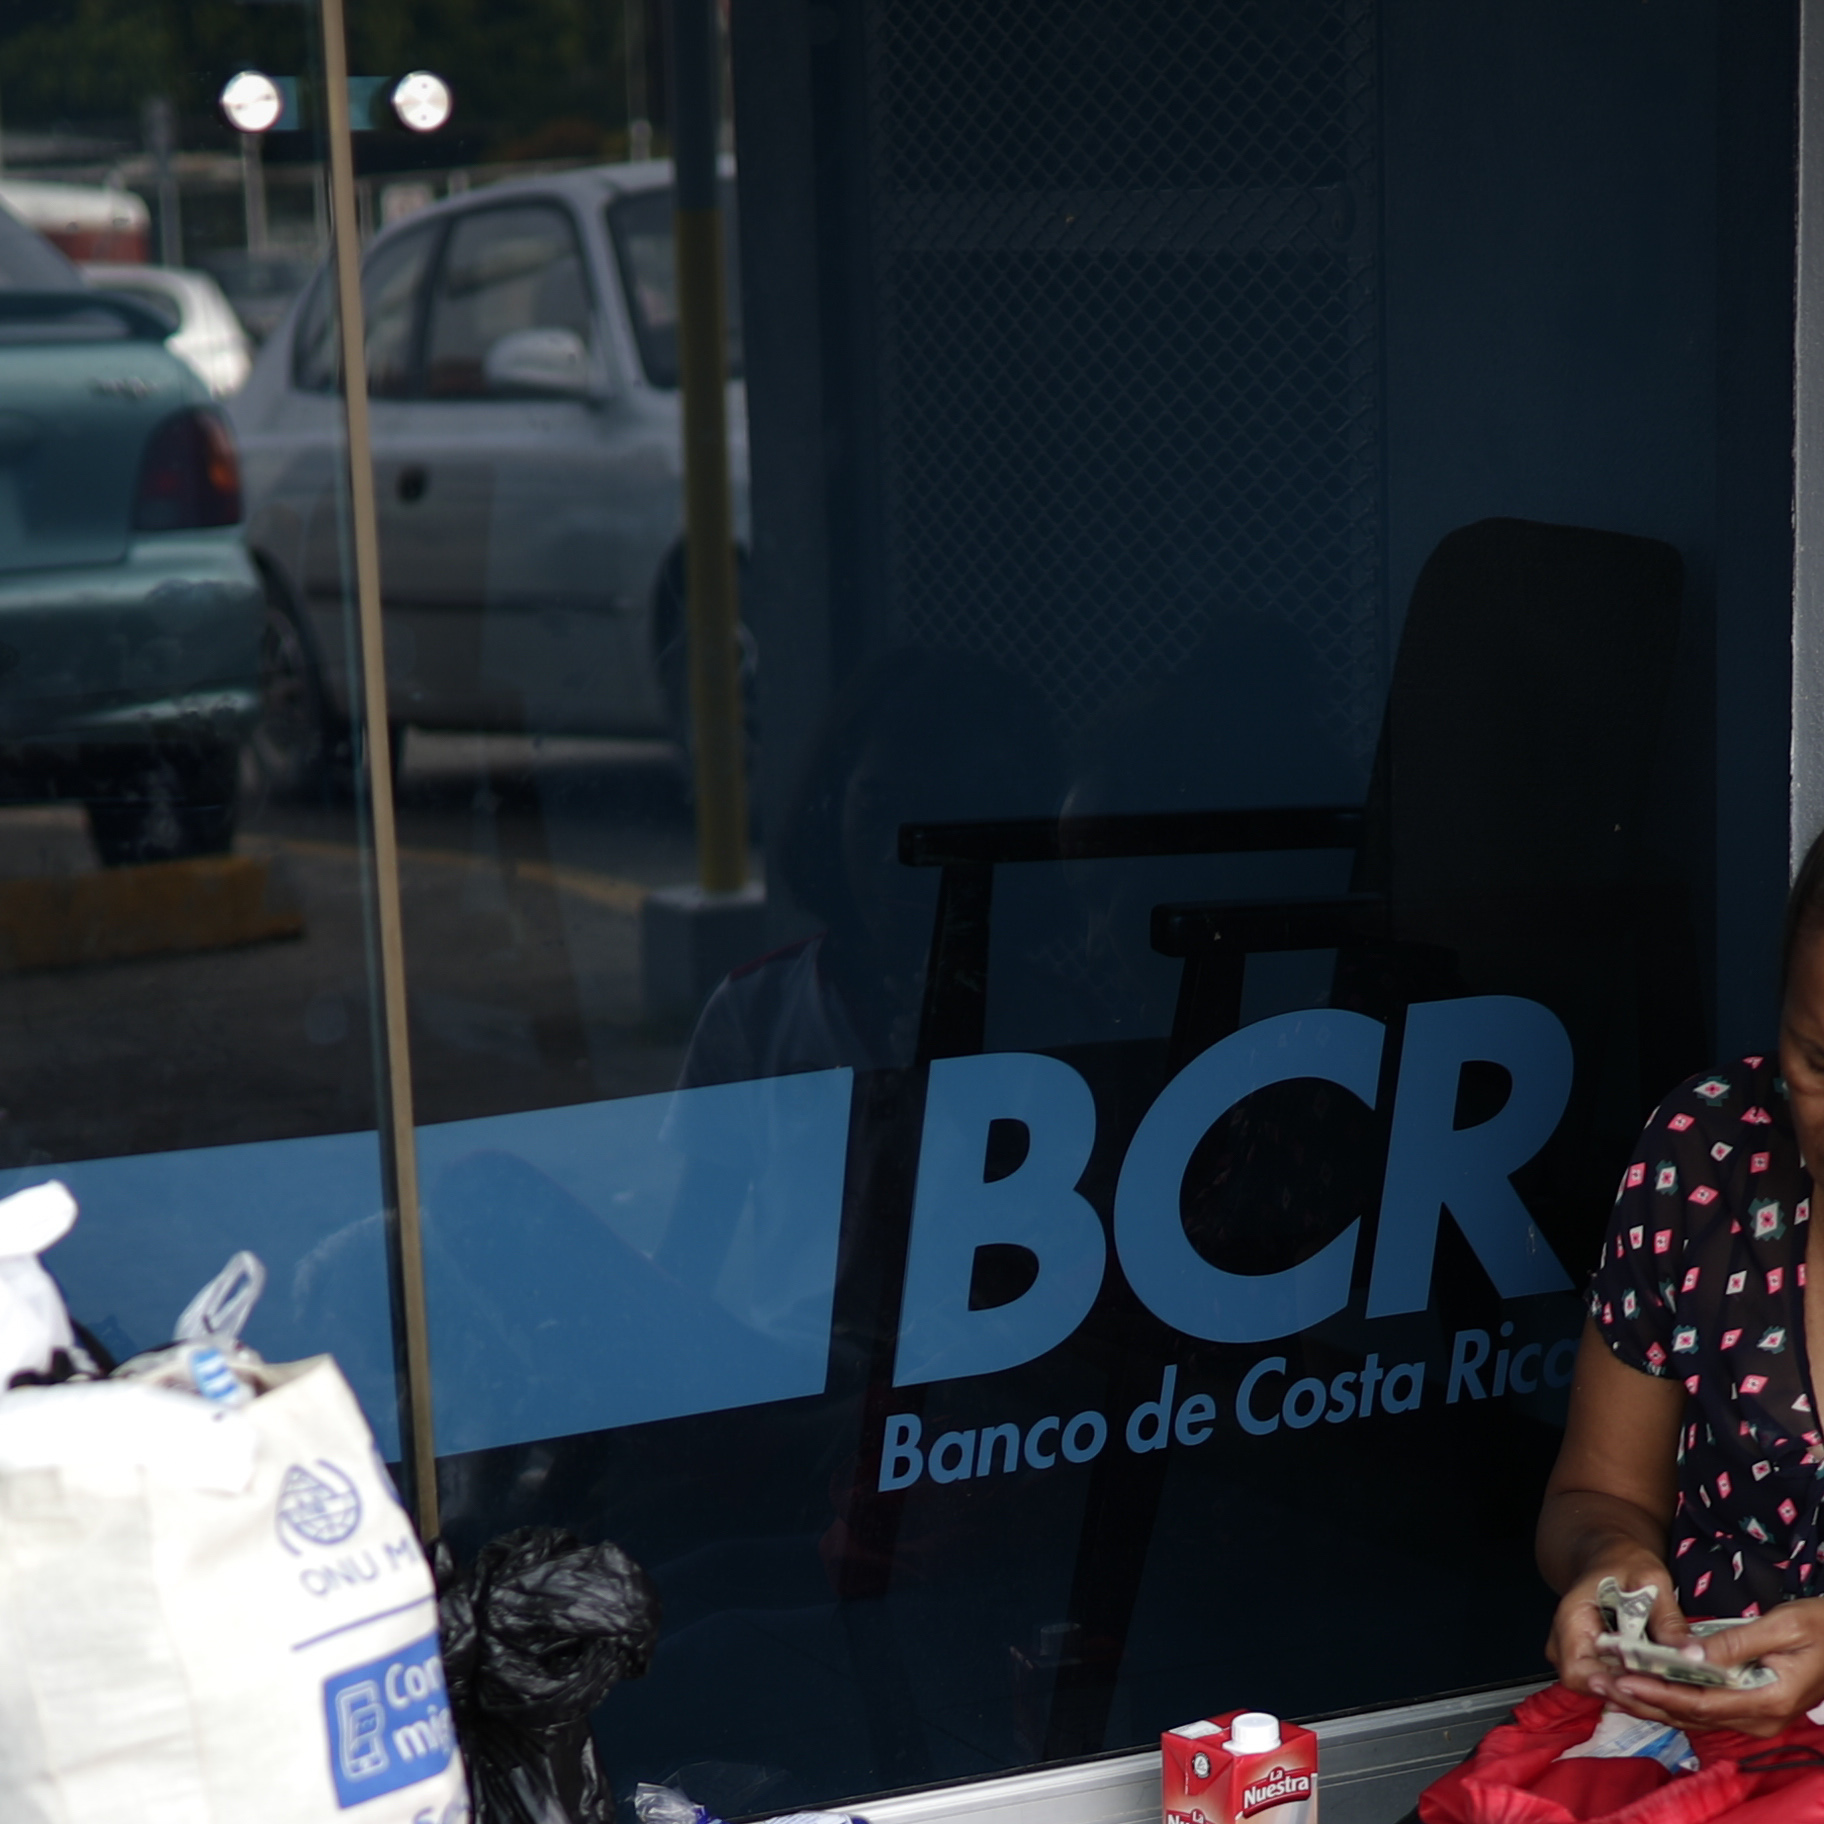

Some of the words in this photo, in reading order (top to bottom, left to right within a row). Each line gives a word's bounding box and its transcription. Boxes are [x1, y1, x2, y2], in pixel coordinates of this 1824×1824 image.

[892, 995, 1576, 1388] BCR
[877, 1410, 1107, 1492] Banco
[1125, 1364, 1216, 1454] de
[1234, 1355, 1425, 1436] Costa
[1444, 1322, 1581, 1402] Rica
[299, 1551, 380, 1597] ONU
[1243, 1775, 1310, 1809] Nuestra
[1270, 1769, 1284, 1782] La
[1192, 1809, 1205, 1824] La
